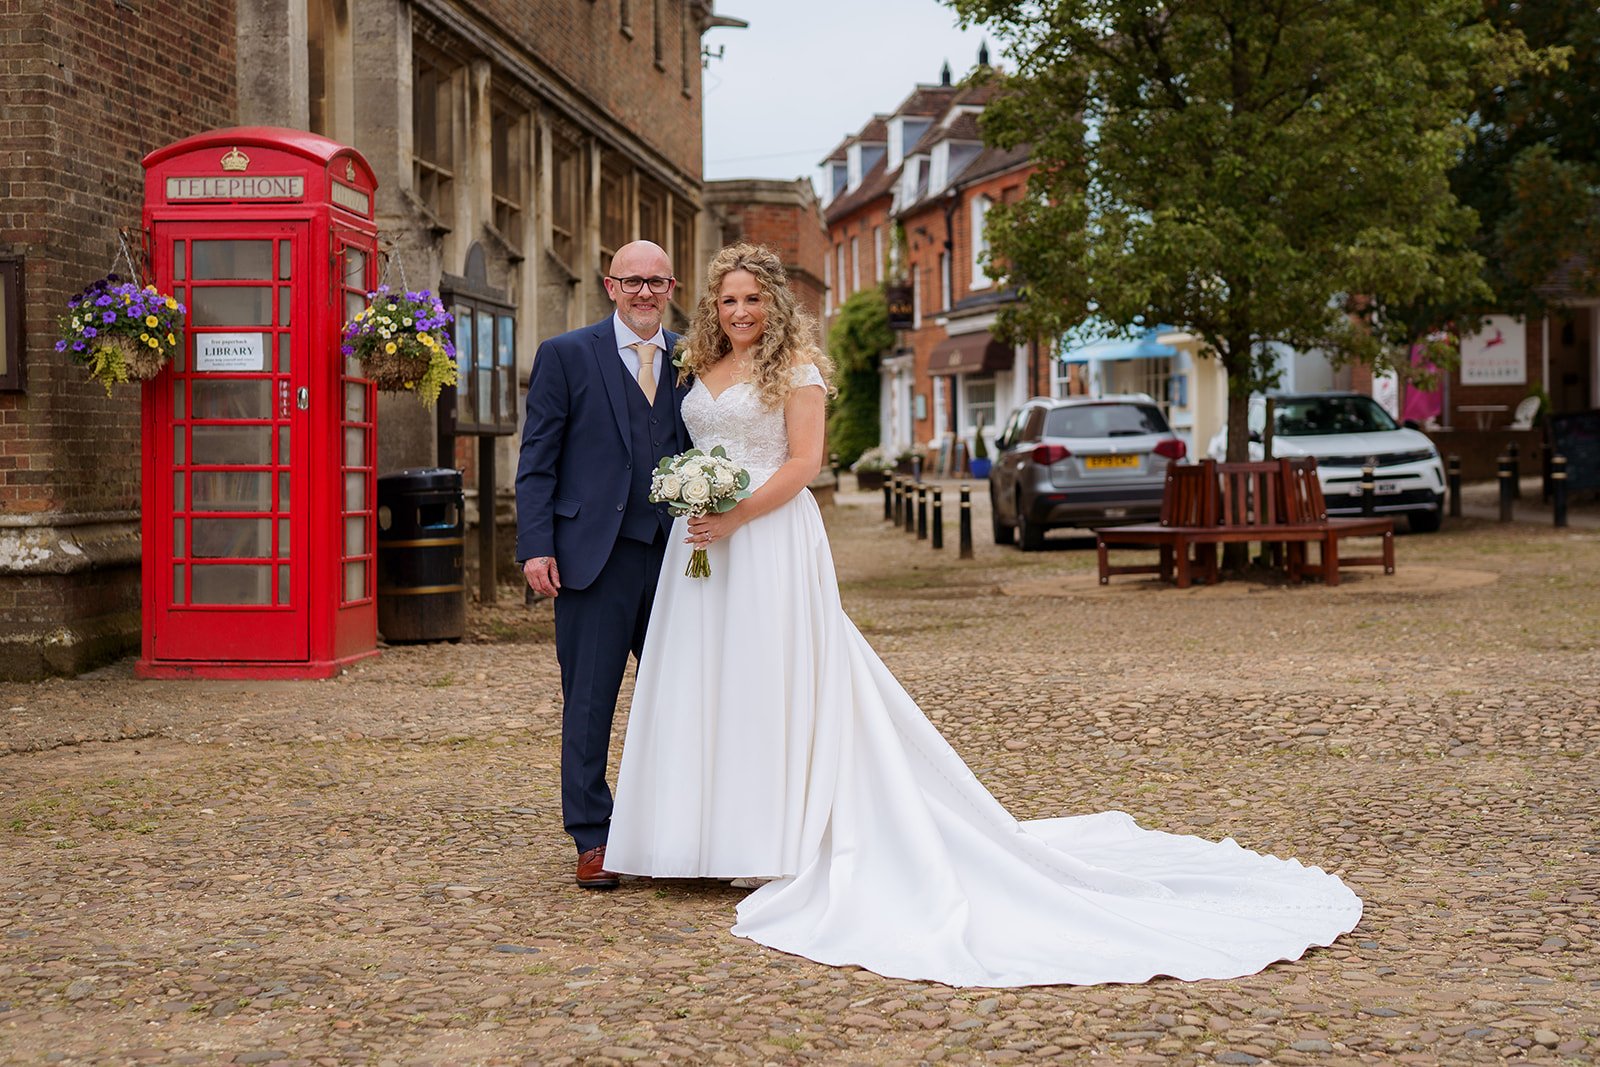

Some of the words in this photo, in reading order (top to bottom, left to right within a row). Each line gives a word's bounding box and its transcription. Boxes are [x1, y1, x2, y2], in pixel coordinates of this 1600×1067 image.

[174, 178, 299, 197] TELEPHONE
[205, 347, 255, 356] LIBRARY
[1468, 367, 1519, 377] GALLERY
